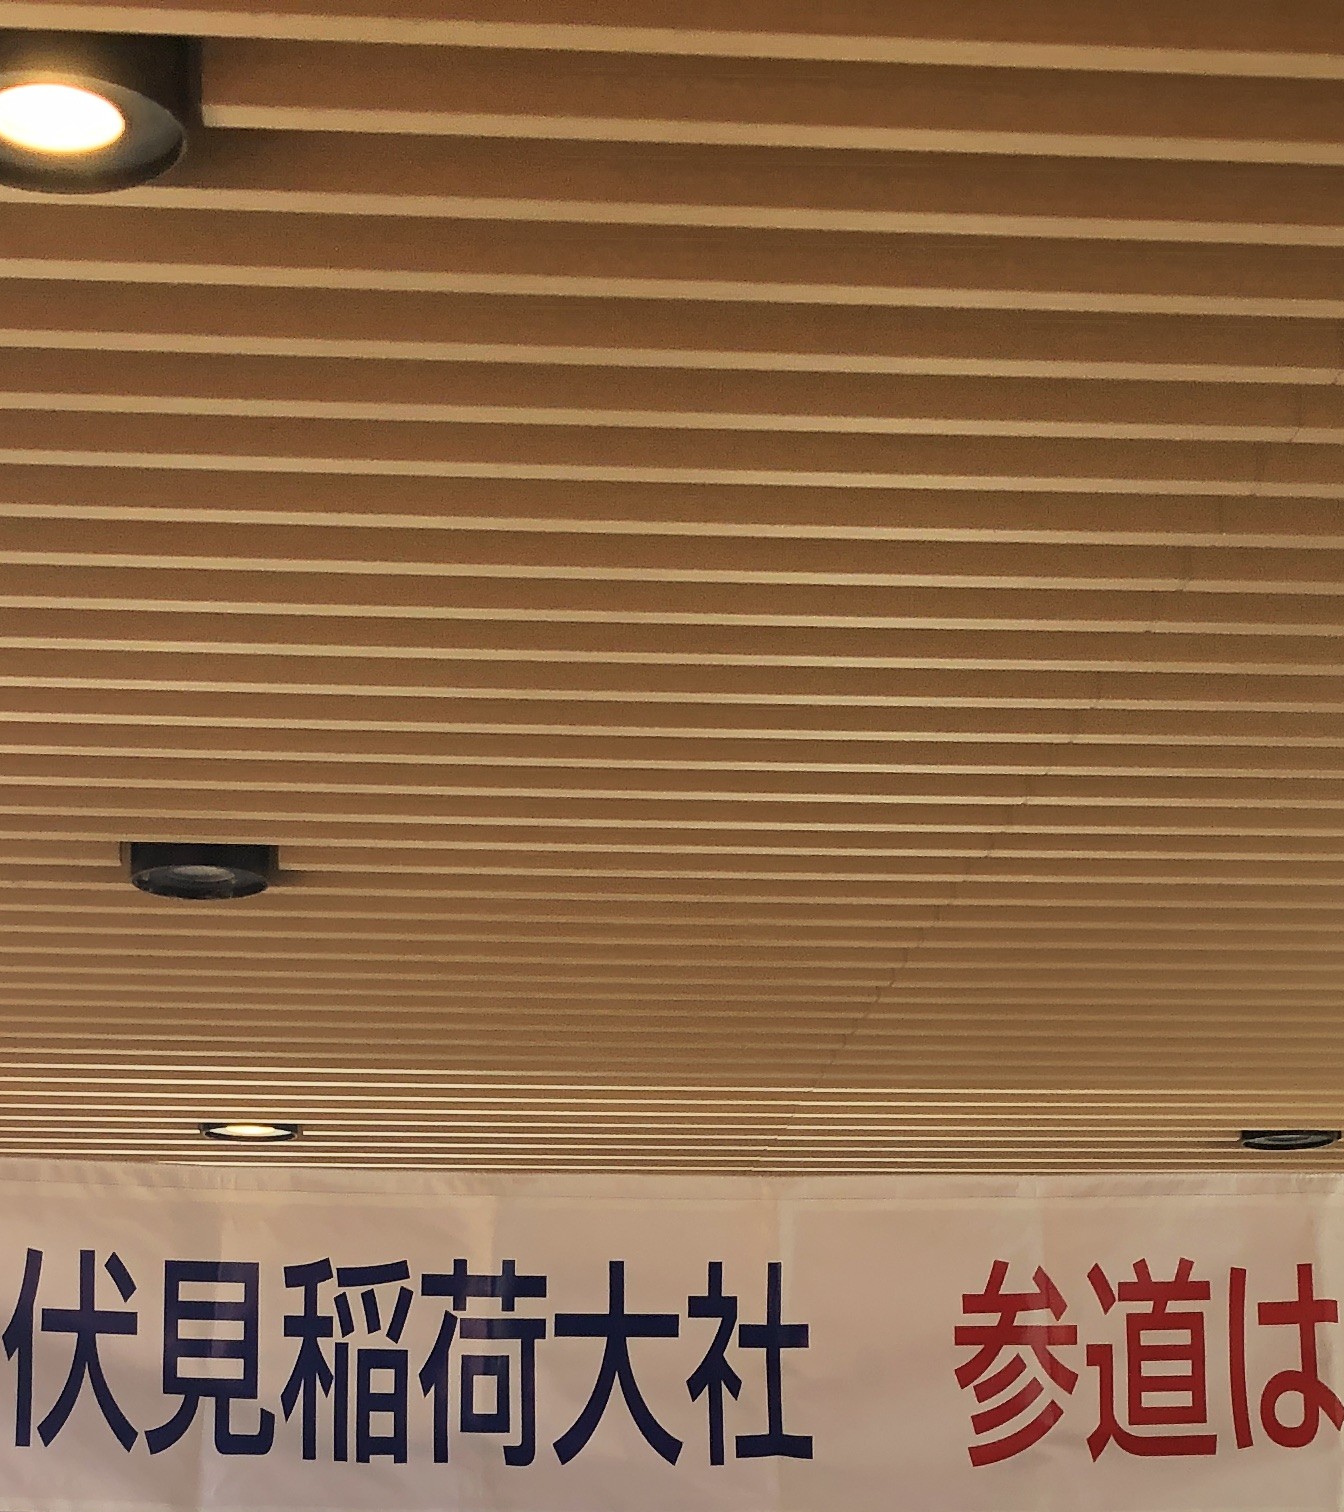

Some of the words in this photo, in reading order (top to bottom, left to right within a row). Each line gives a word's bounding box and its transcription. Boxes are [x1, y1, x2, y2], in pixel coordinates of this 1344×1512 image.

[0, 1246, 814, 1468] 伏見稲荷大社
